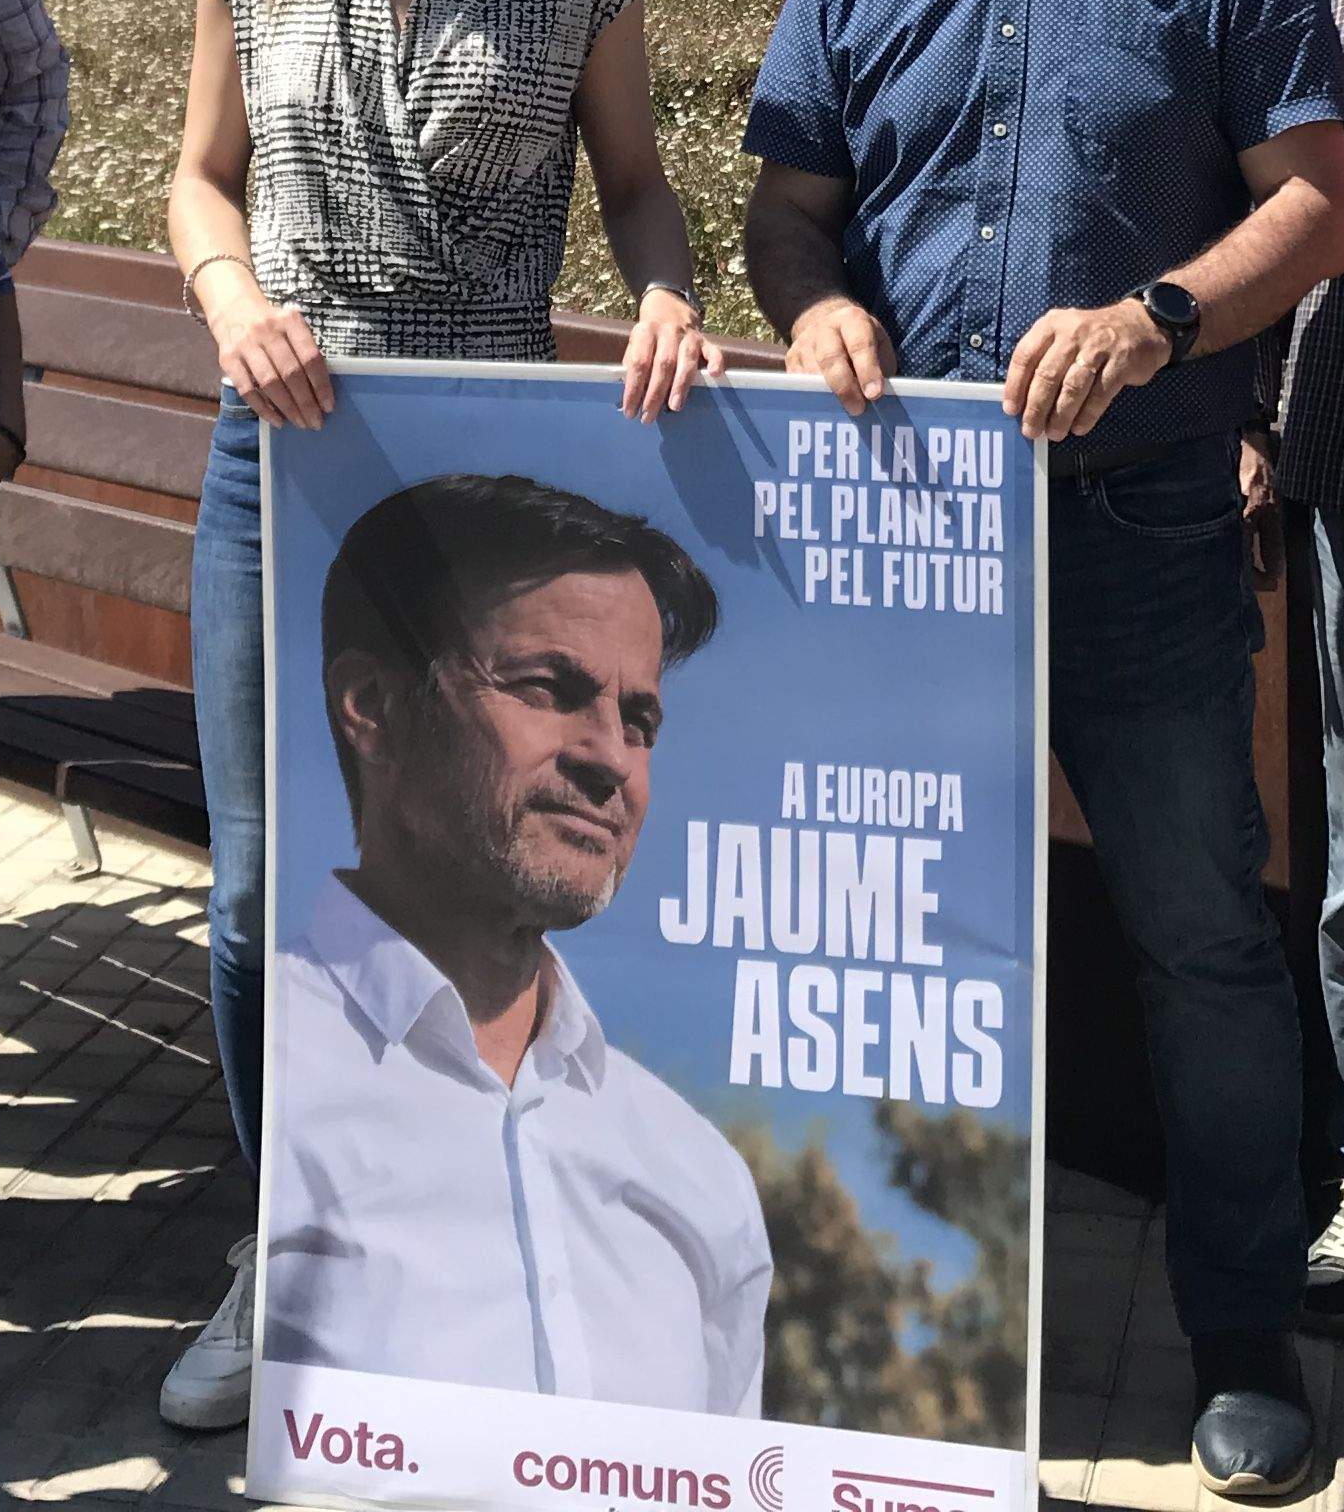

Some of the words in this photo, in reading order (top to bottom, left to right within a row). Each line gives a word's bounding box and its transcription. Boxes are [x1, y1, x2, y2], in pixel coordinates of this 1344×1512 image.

[788, 419, 860, 481] PER
[871, 424, 917, 483] LA
[927, 427, 1004, 488] PAU
[754, 480, 820, 541] PEL
[831, 484, 1004, 552] PLANETA
[804, 545, 872, 607] PEL
[882, 550, 1004, 616] FUTUR
[781, 761, 806, 820] A
[816, 764, 964, 832] EUROPA
[659, 820, 944, 967] JAUME
[729, 958, 1004, 1109] ASENS
[281, 1407, 420, 1475] Vota.
[512, 1450, 732, 1510] comuns
